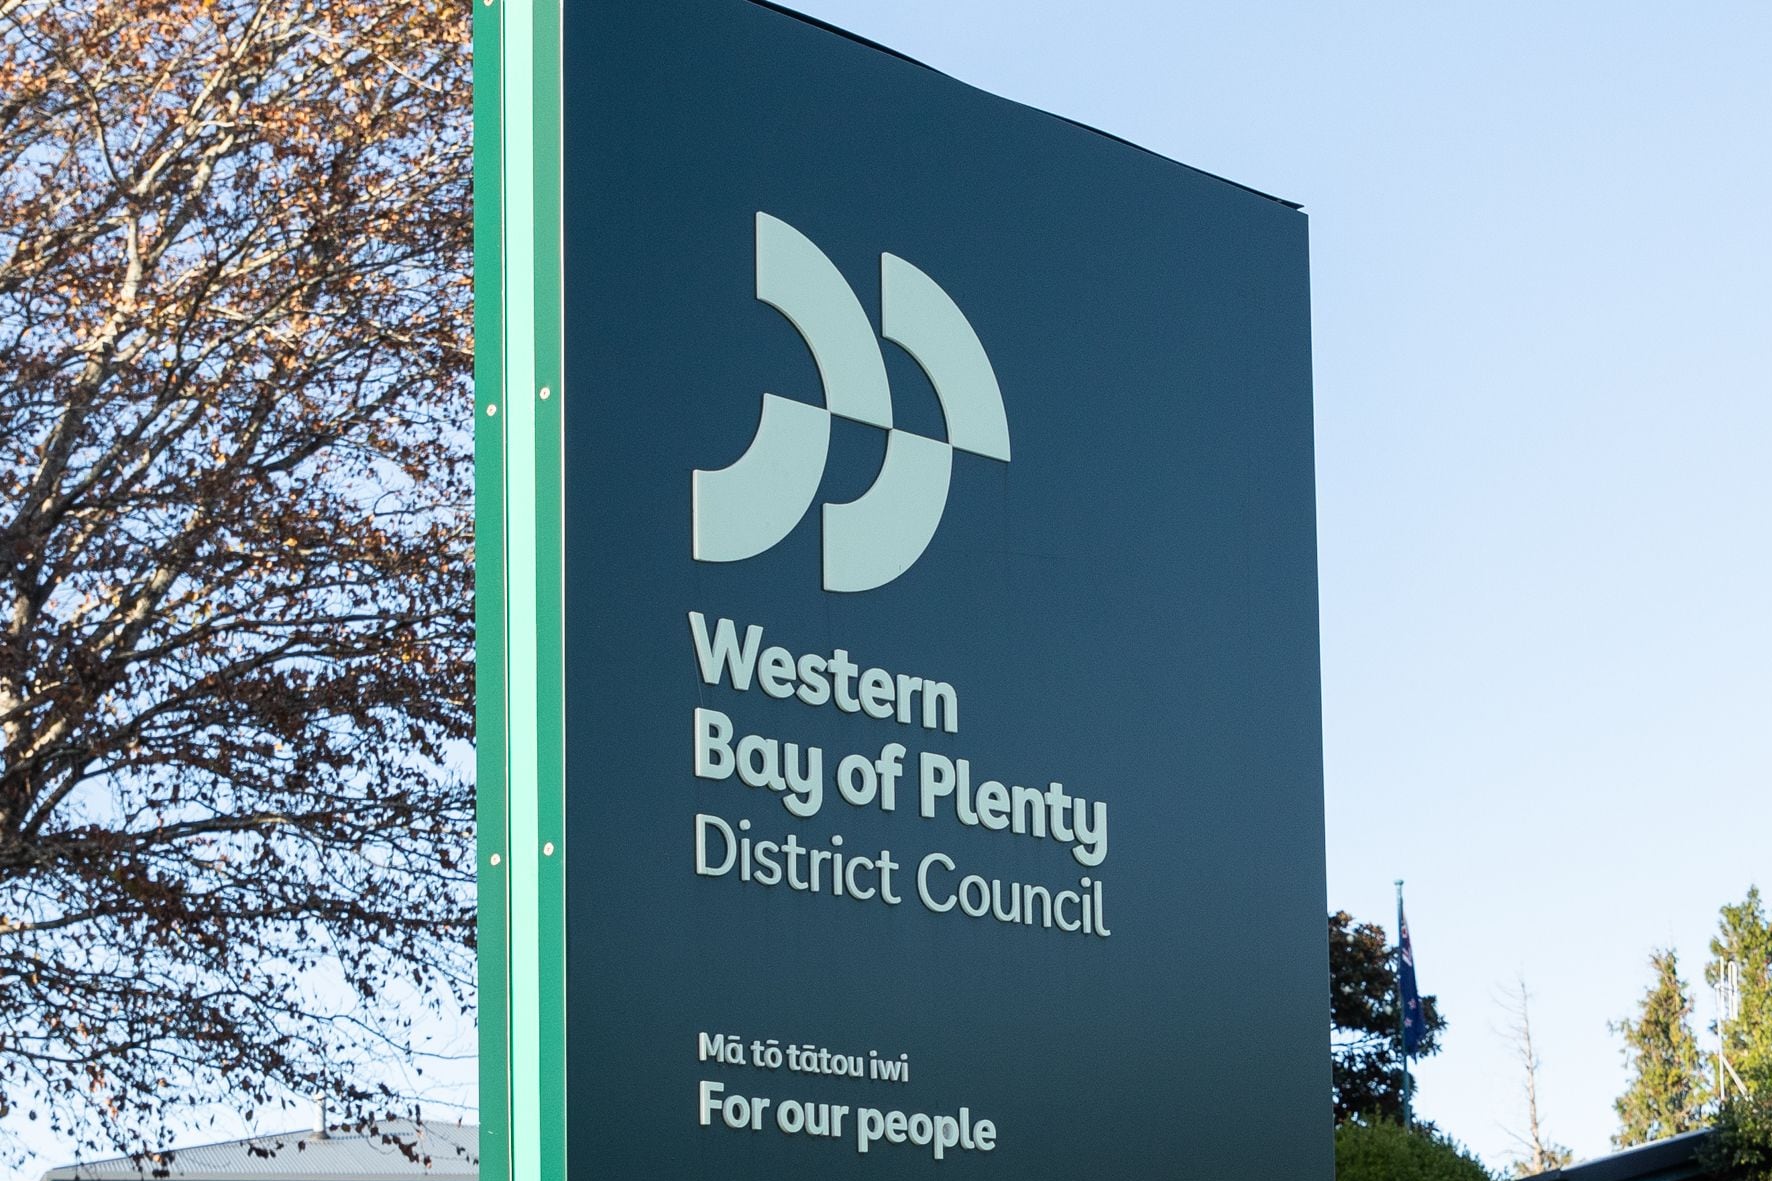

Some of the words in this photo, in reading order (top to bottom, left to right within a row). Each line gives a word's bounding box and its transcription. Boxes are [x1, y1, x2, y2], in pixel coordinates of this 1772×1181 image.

[688, 611, 959, 733] Western
[694, 707, 824, 817] Bay
[836, 743, 907, 811] of
[919, 752, 1108, 866] Plenty
[695, 813, 902, 905] District
[917, 852, 1112, 937] Council
[699, 1032, 747, 1066] Mā
[750, 1039, 783, 1069] tō
[786, 1044, 864, 1077] tātou
[869, 1050, 909, 1082] iwi
[699, 1080, 771, 1130] For
[776, 1099, 849, 1137] our
[857, 1107, 997, 1159] people
